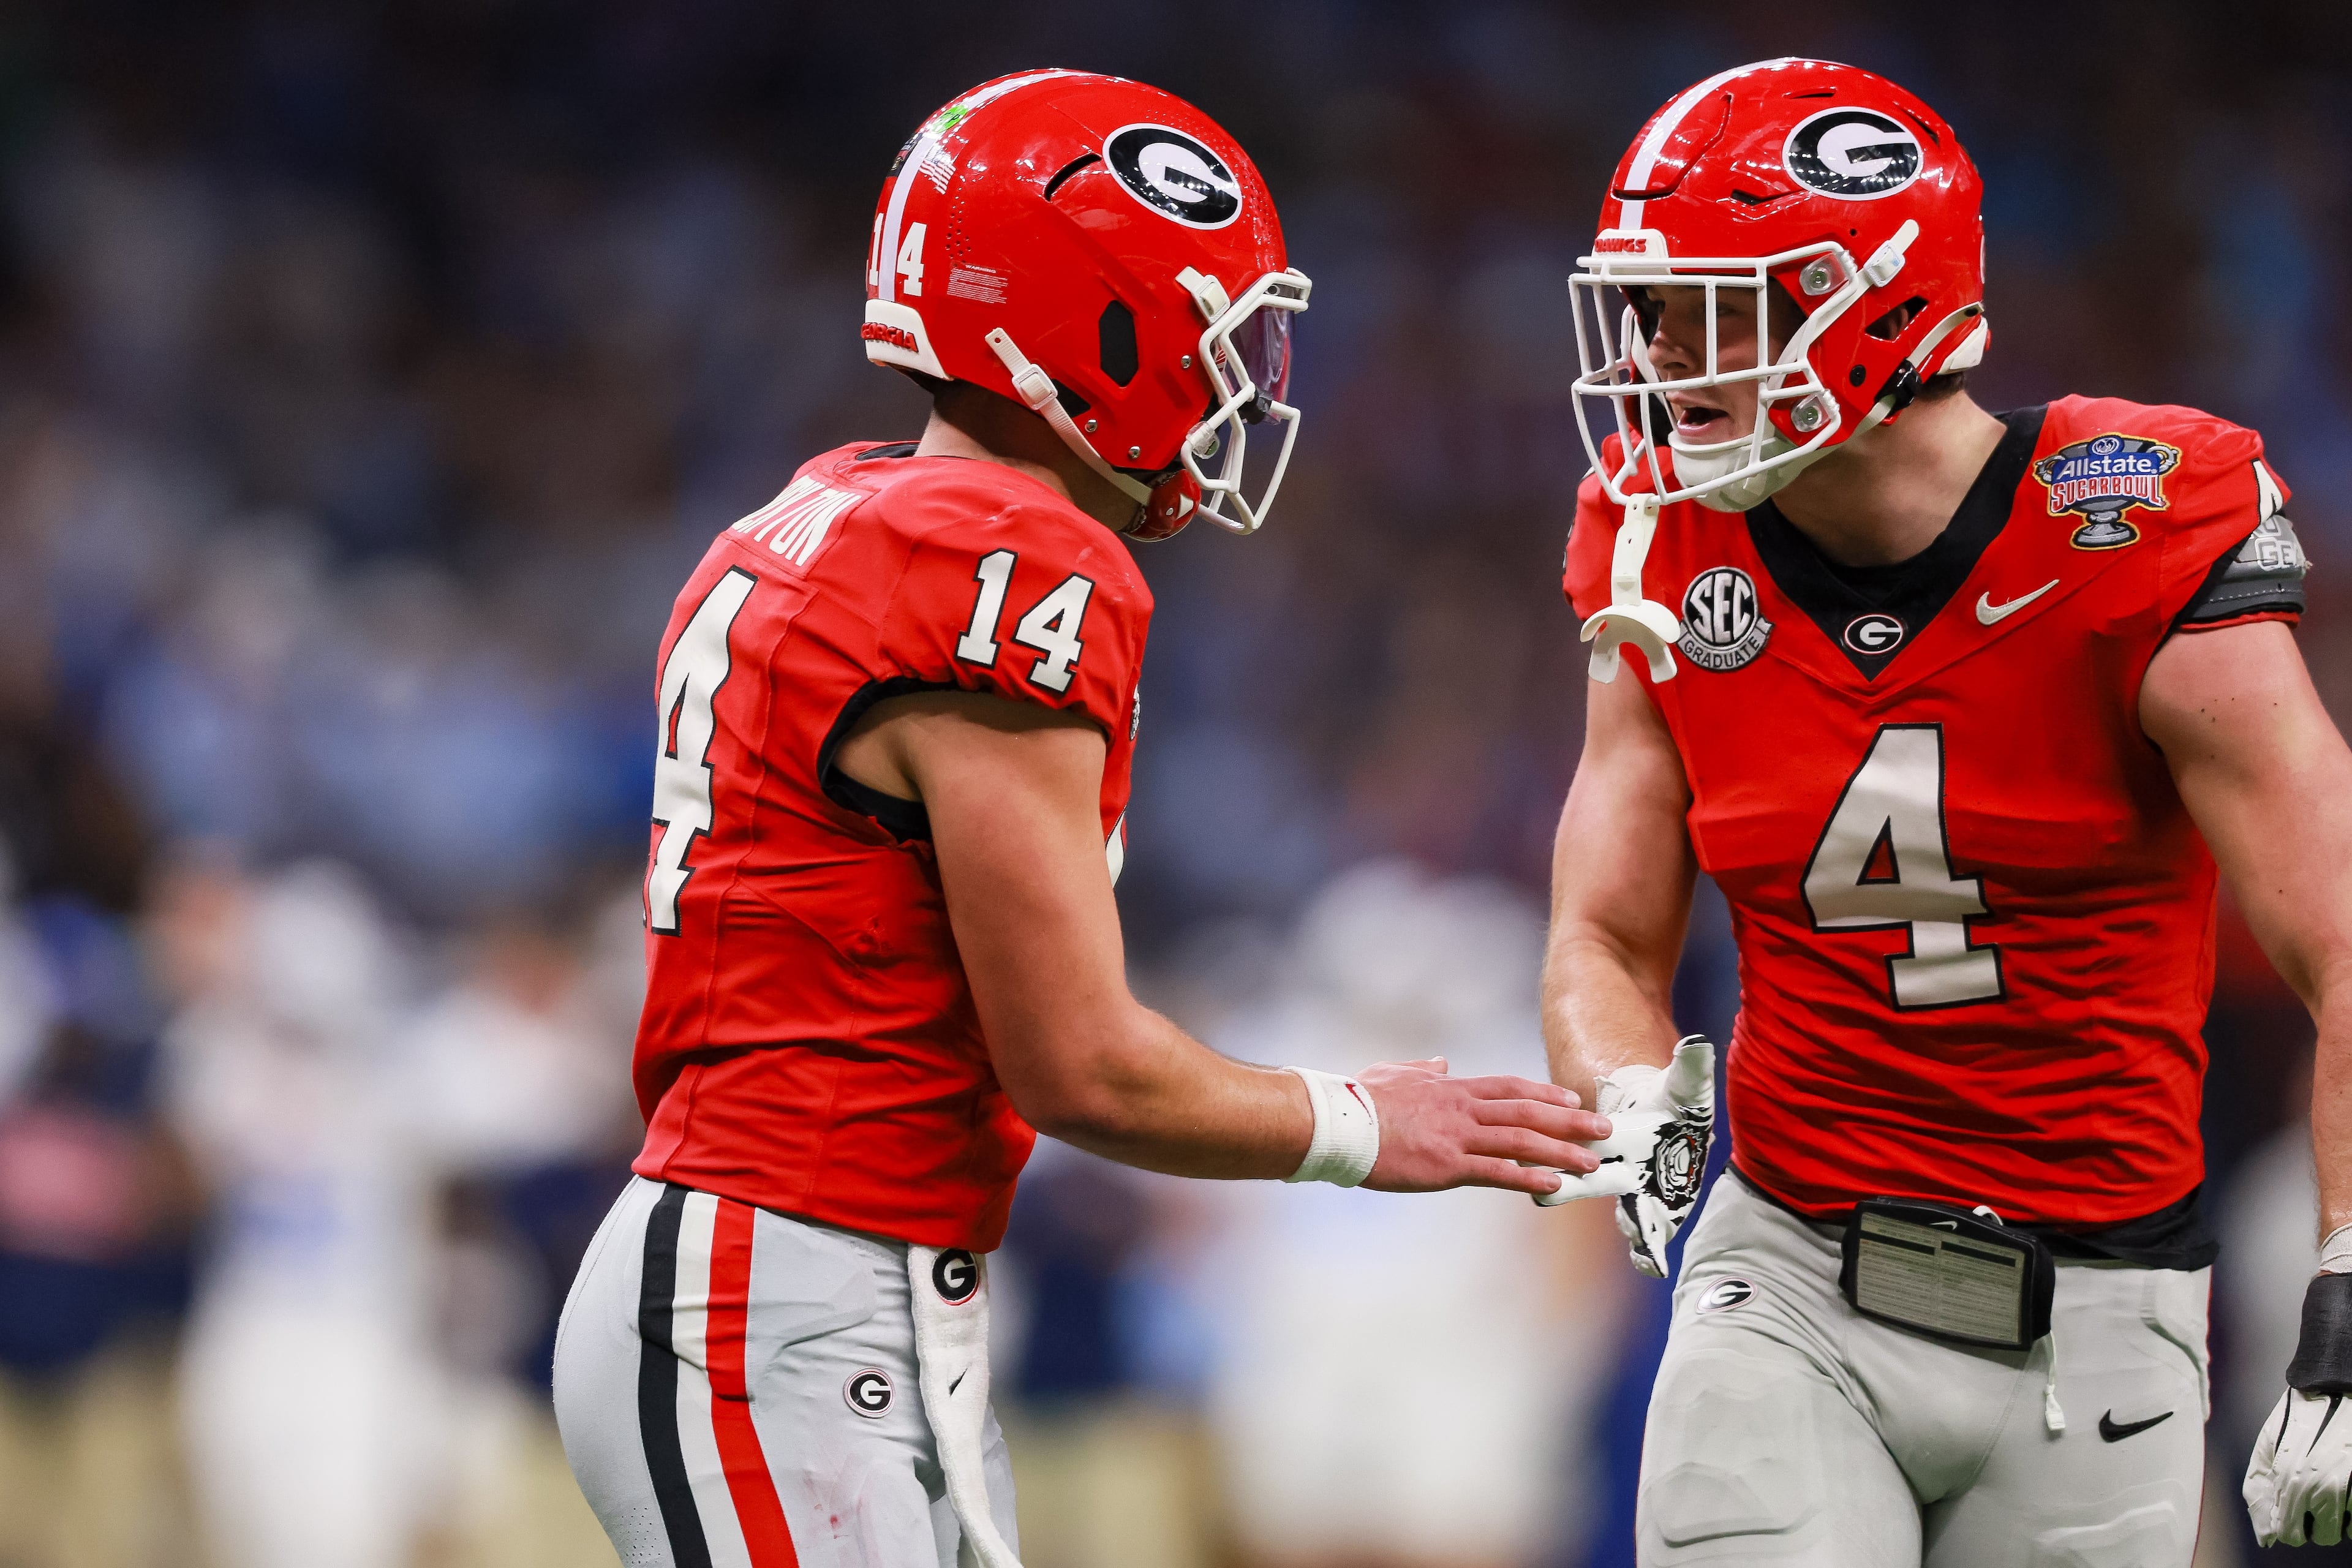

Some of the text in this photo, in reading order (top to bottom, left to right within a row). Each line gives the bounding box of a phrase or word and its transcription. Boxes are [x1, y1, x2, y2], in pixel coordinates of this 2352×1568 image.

[1109, 128, 1238, 224] G
[1787, 111, 1918, 194] G
[965, 264, 997, 274] WARNING
[1594, 238, 1646, 253] DAWGS
[954, 548, 1095, 696] 14
[1689, 572, 1751, 643] SEC
[1846, 616, 1901, 652] G
[1684, 636, 1760, 668] GRADUATE
[644, 564, 760, 937] 4
[1799, 722, 2007, 1012] 4
[932, 1248, 978, 1302] G
[849, 1373, 891, 1411] G
